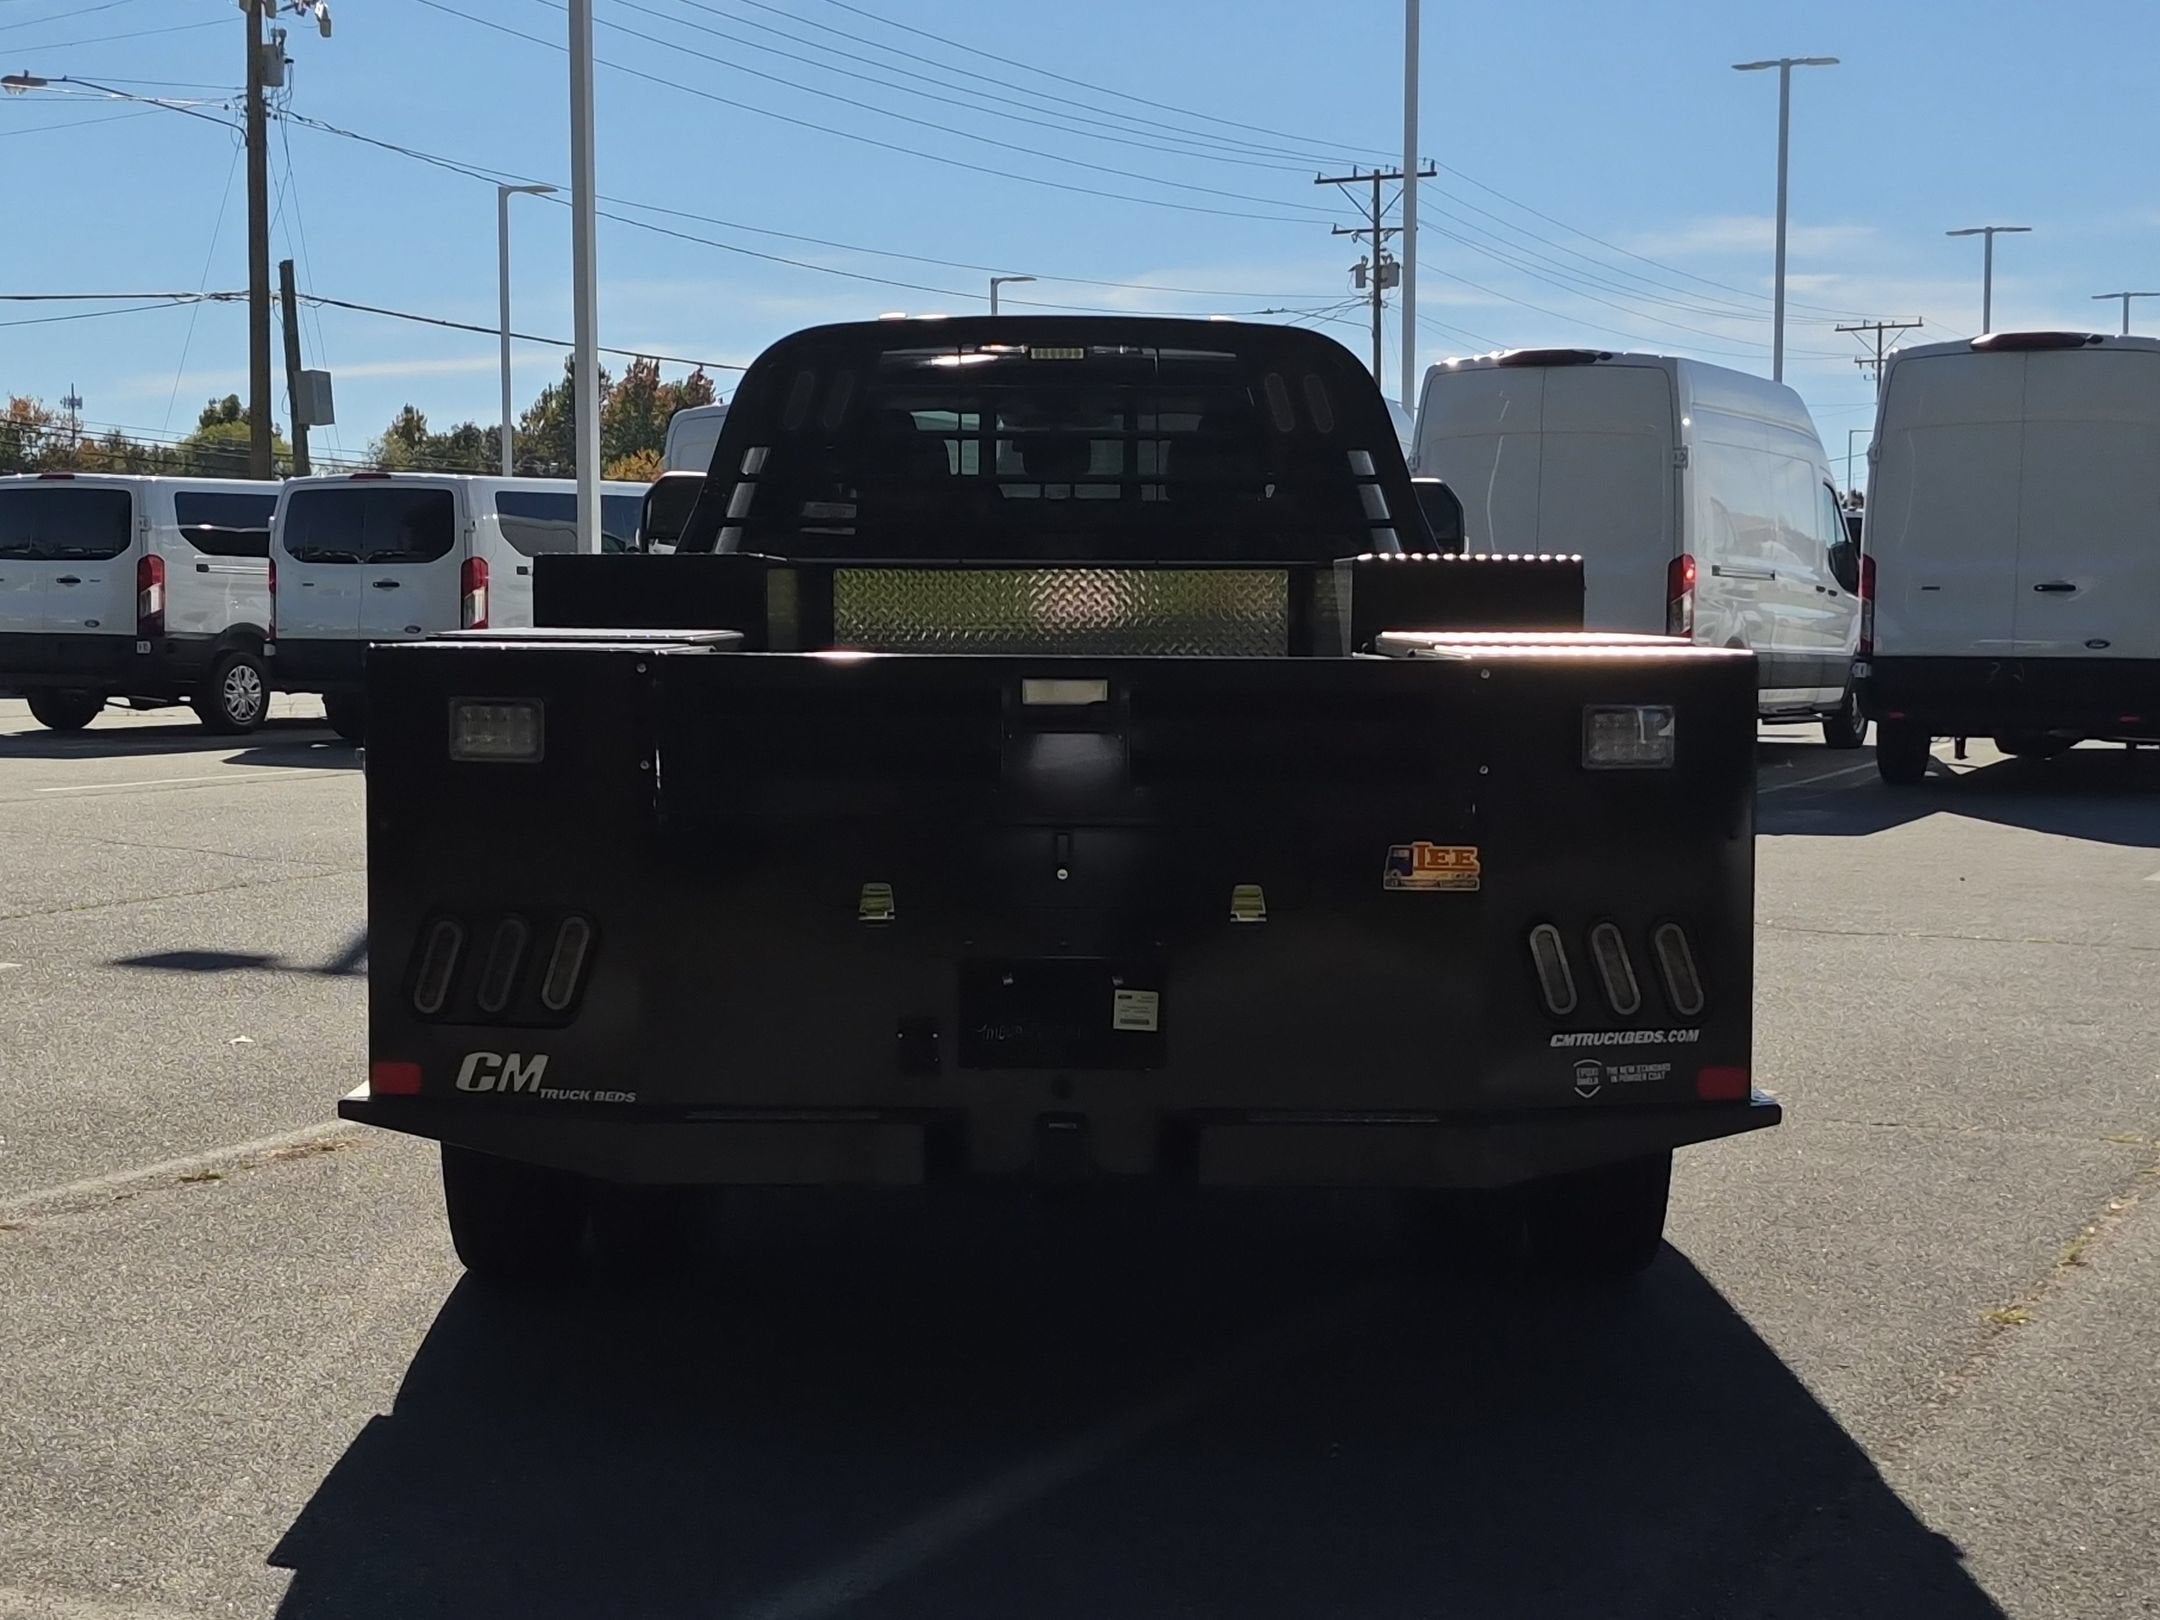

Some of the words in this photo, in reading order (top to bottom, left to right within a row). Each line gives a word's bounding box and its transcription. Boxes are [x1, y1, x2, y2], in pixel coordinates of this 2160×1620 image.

[1412, 844, 1478, 870] LEE
[1550, 1028, 1700, 1047] CMTRUCKBEDS.COM
[455, 1051, 550, 1092] CM
[538, 1087, 593, 1101] TRUCK
[593, 1091, 637, 1103] BEDS
